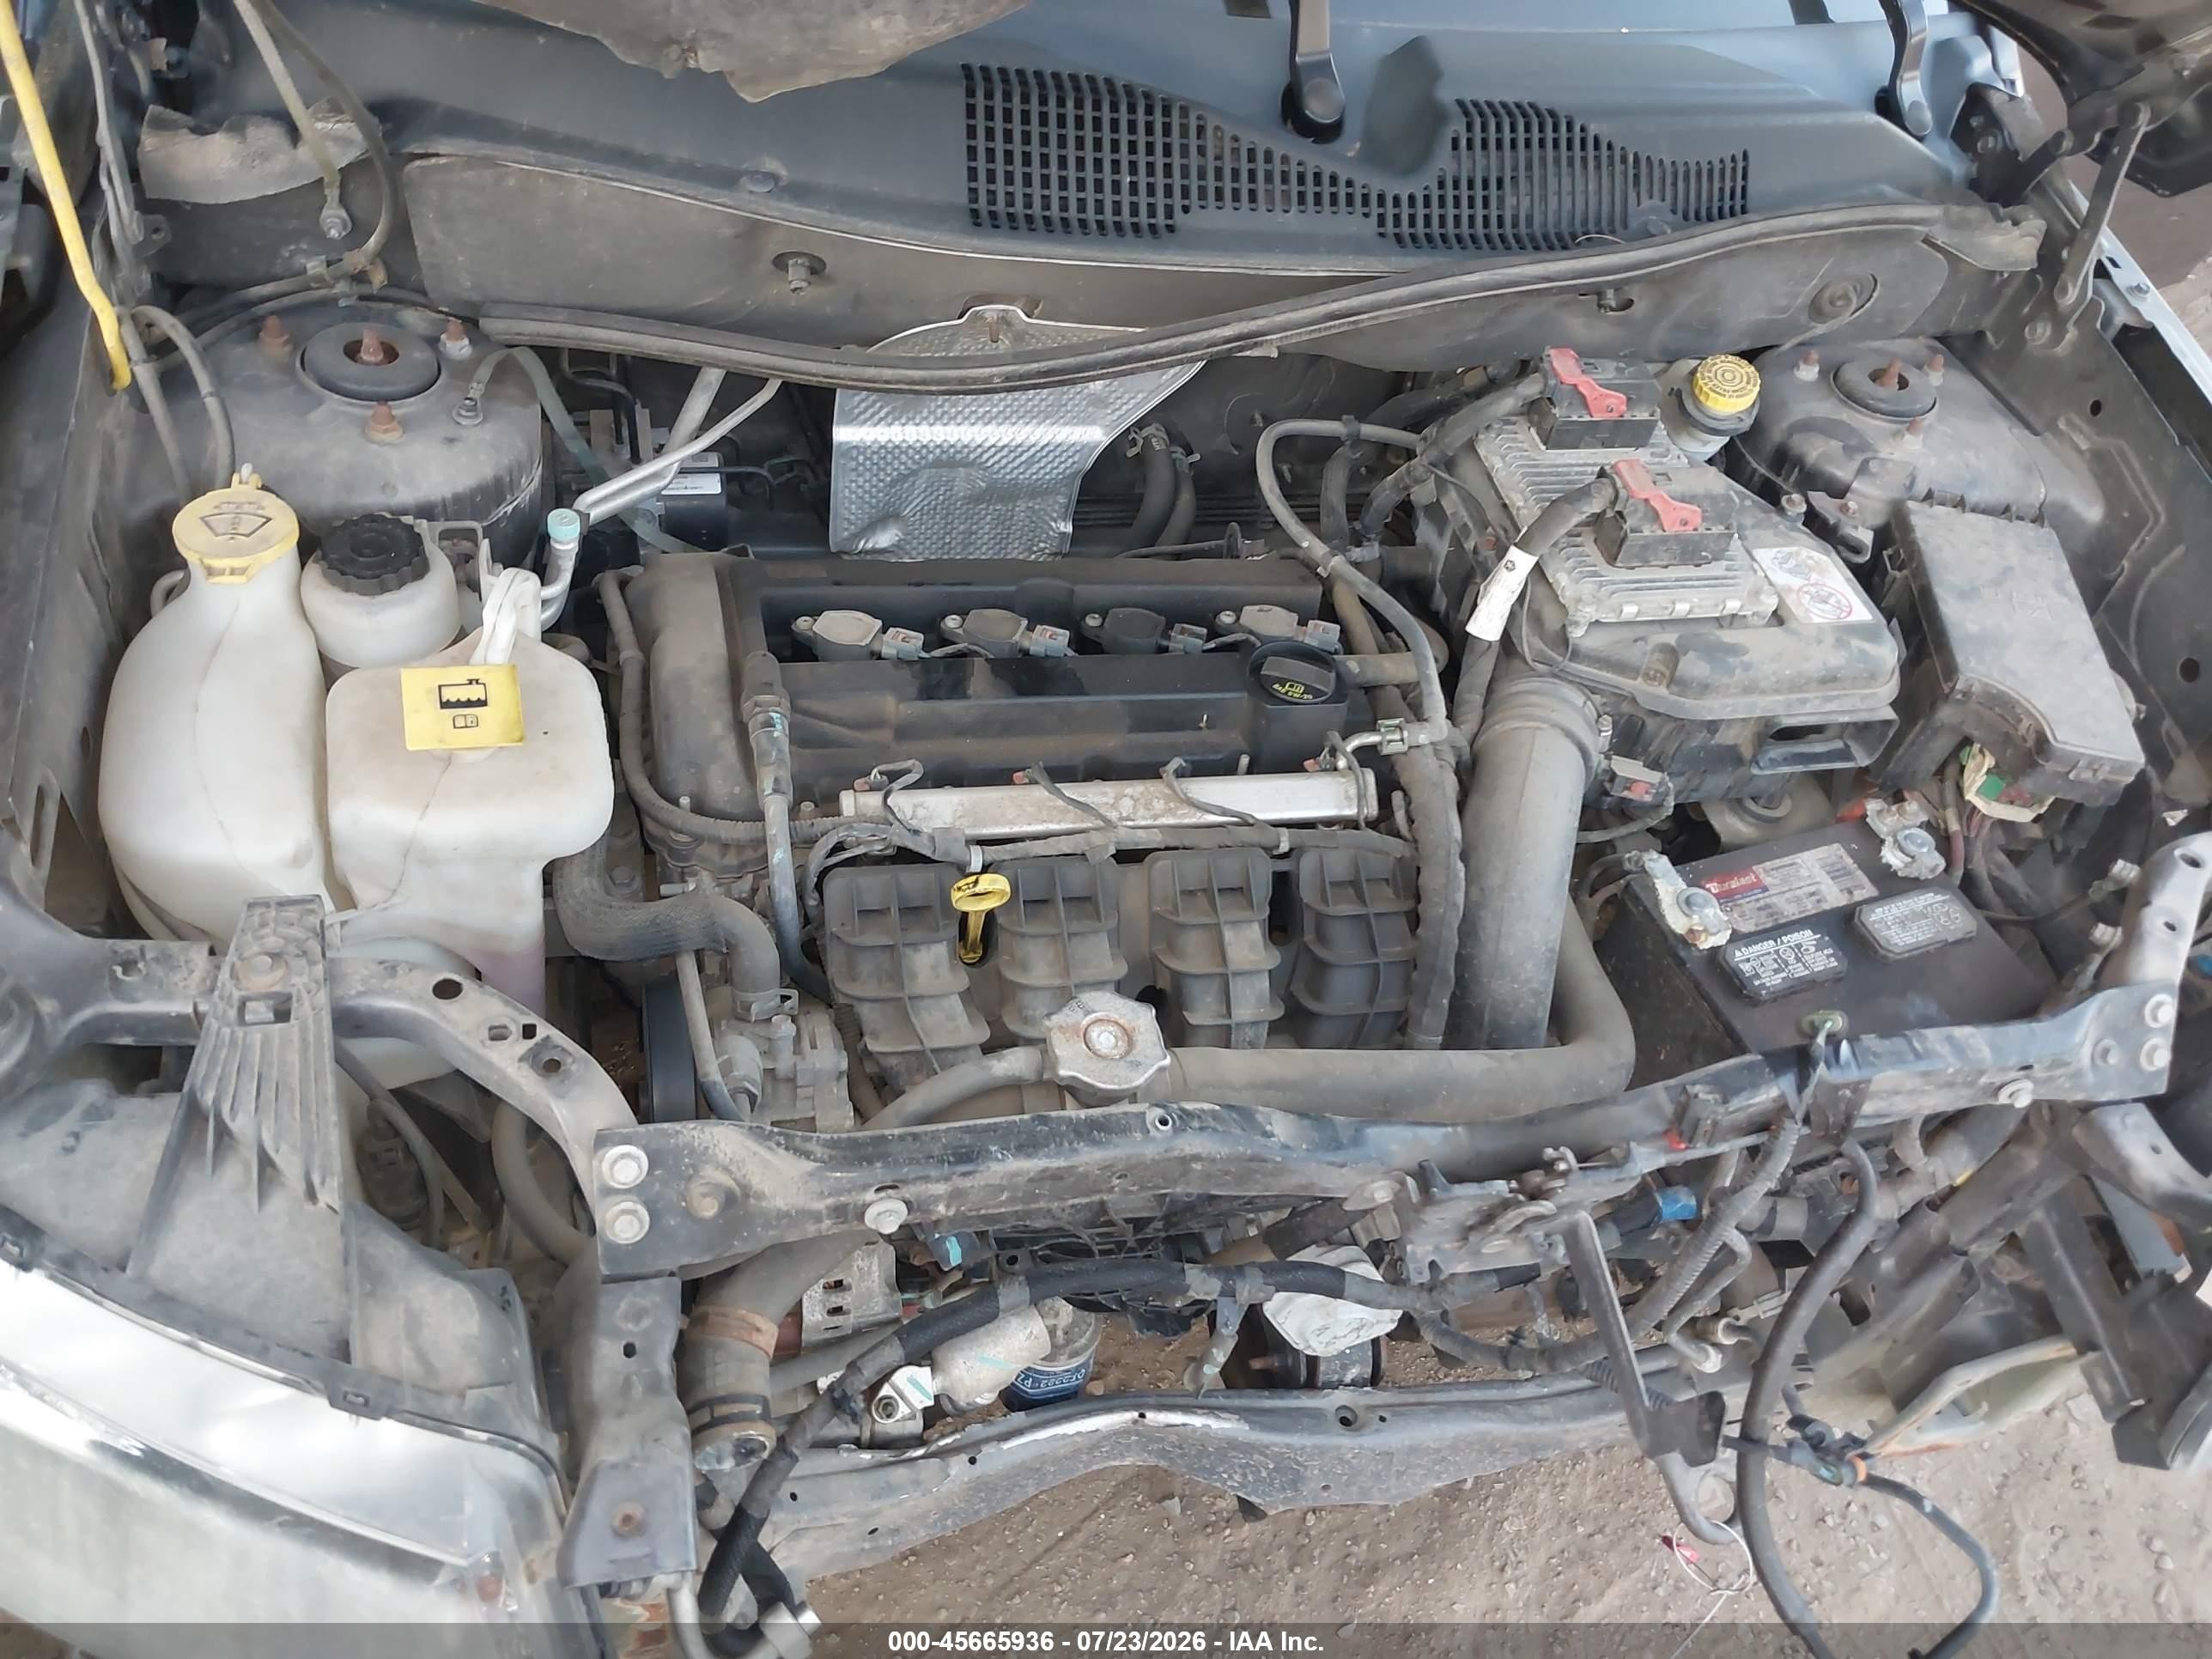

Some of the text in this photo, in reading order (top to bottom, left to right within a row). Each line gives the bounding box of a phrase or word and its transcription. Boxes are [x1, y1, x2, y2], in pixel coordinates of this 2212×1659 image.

[1705, 872, 1758, 894] Duralast
[1741, 939, 1777, 954] DANGER
[1782, 929, 1814, 943] POISON
